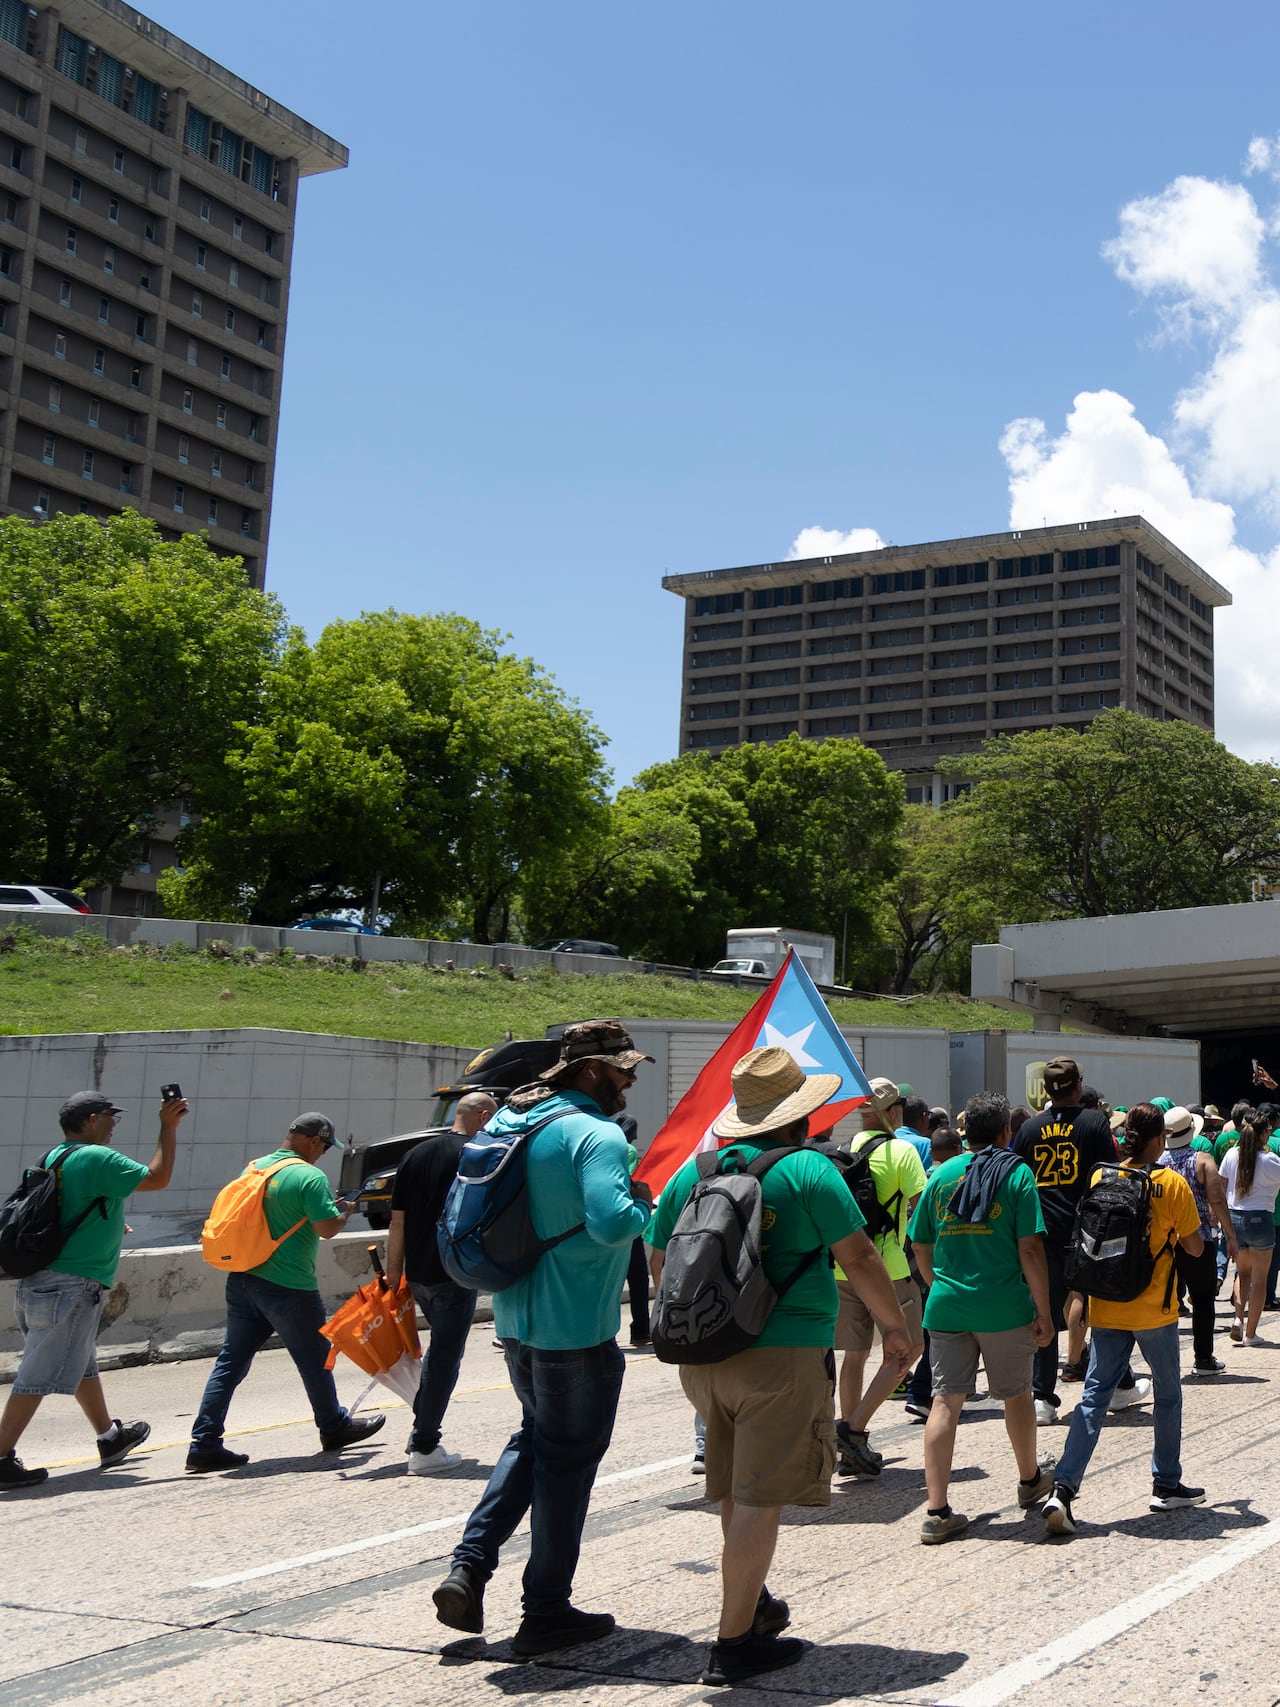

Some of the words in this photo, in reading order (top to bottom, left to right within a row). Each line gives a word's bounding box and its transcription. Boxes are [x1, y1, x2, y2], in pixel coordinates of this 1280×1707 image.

[1028, 1078, 1051, 1108] up
[1040, 1122, 1074, 1140] JAMES
[1034, 1142, 1079, 1187] 23
